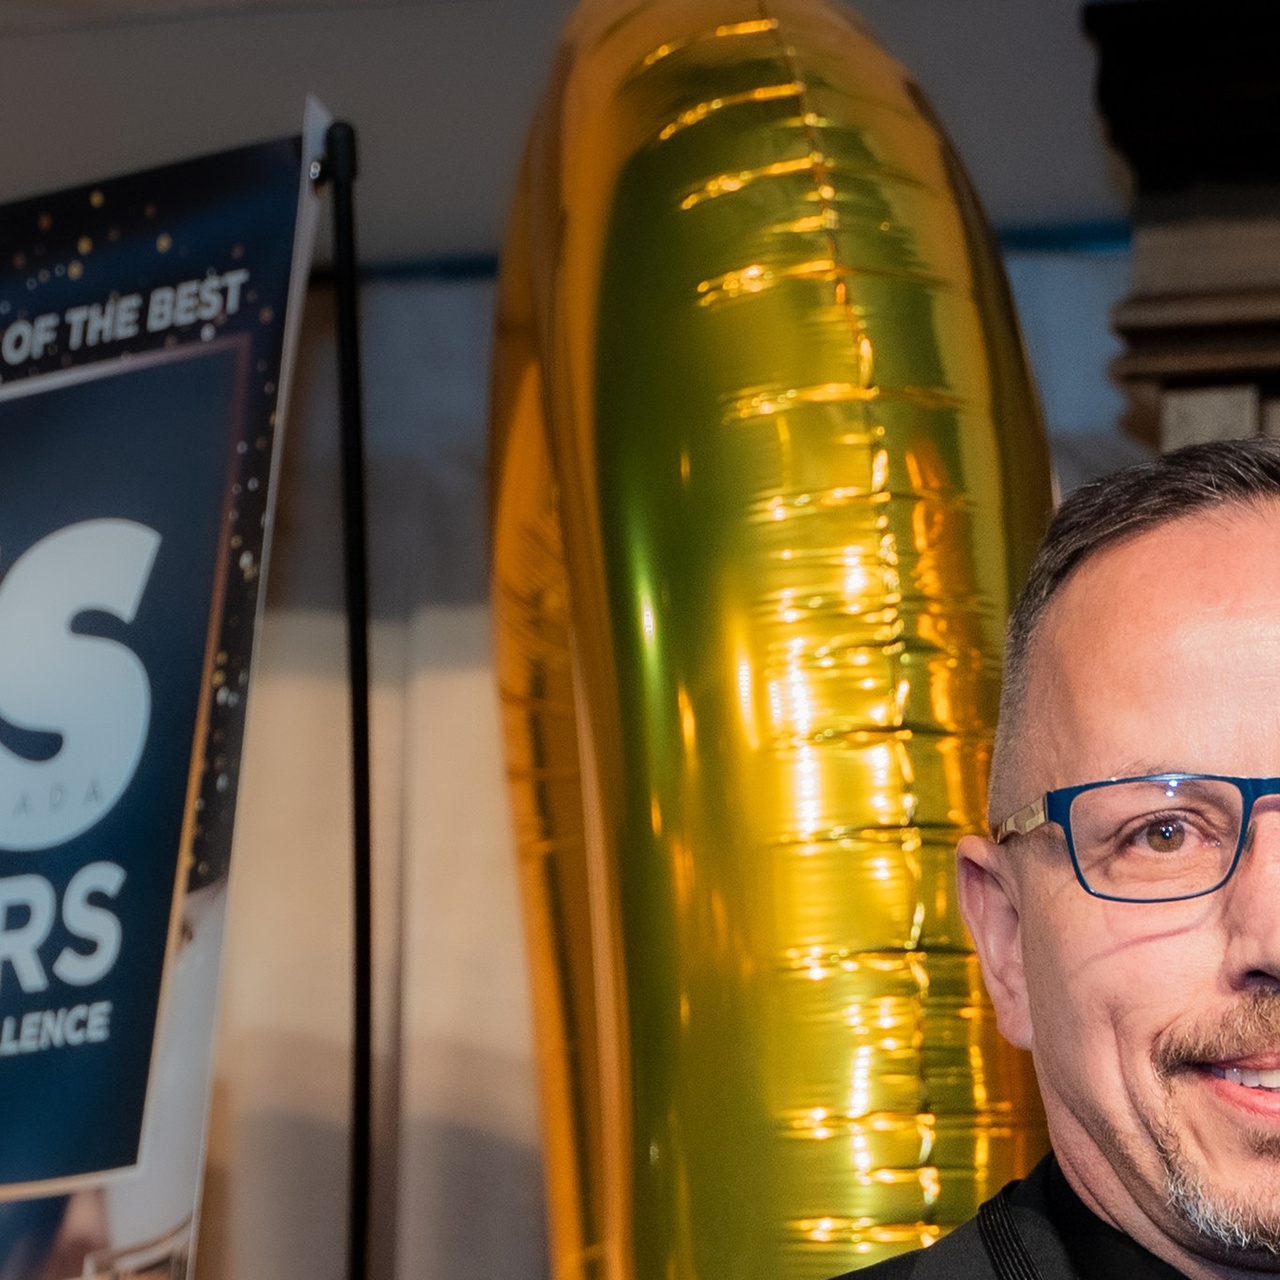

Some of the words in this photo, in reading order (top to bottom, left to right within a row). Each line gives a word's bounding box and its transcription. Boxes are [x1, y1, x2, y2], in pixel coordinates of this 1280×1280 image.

[2, 313, 60, 366] OF
[65, 294, 143, 351] THE
[146, 268, 250, 335] BEST
[0, 1000, 114, 1056] LENCE
